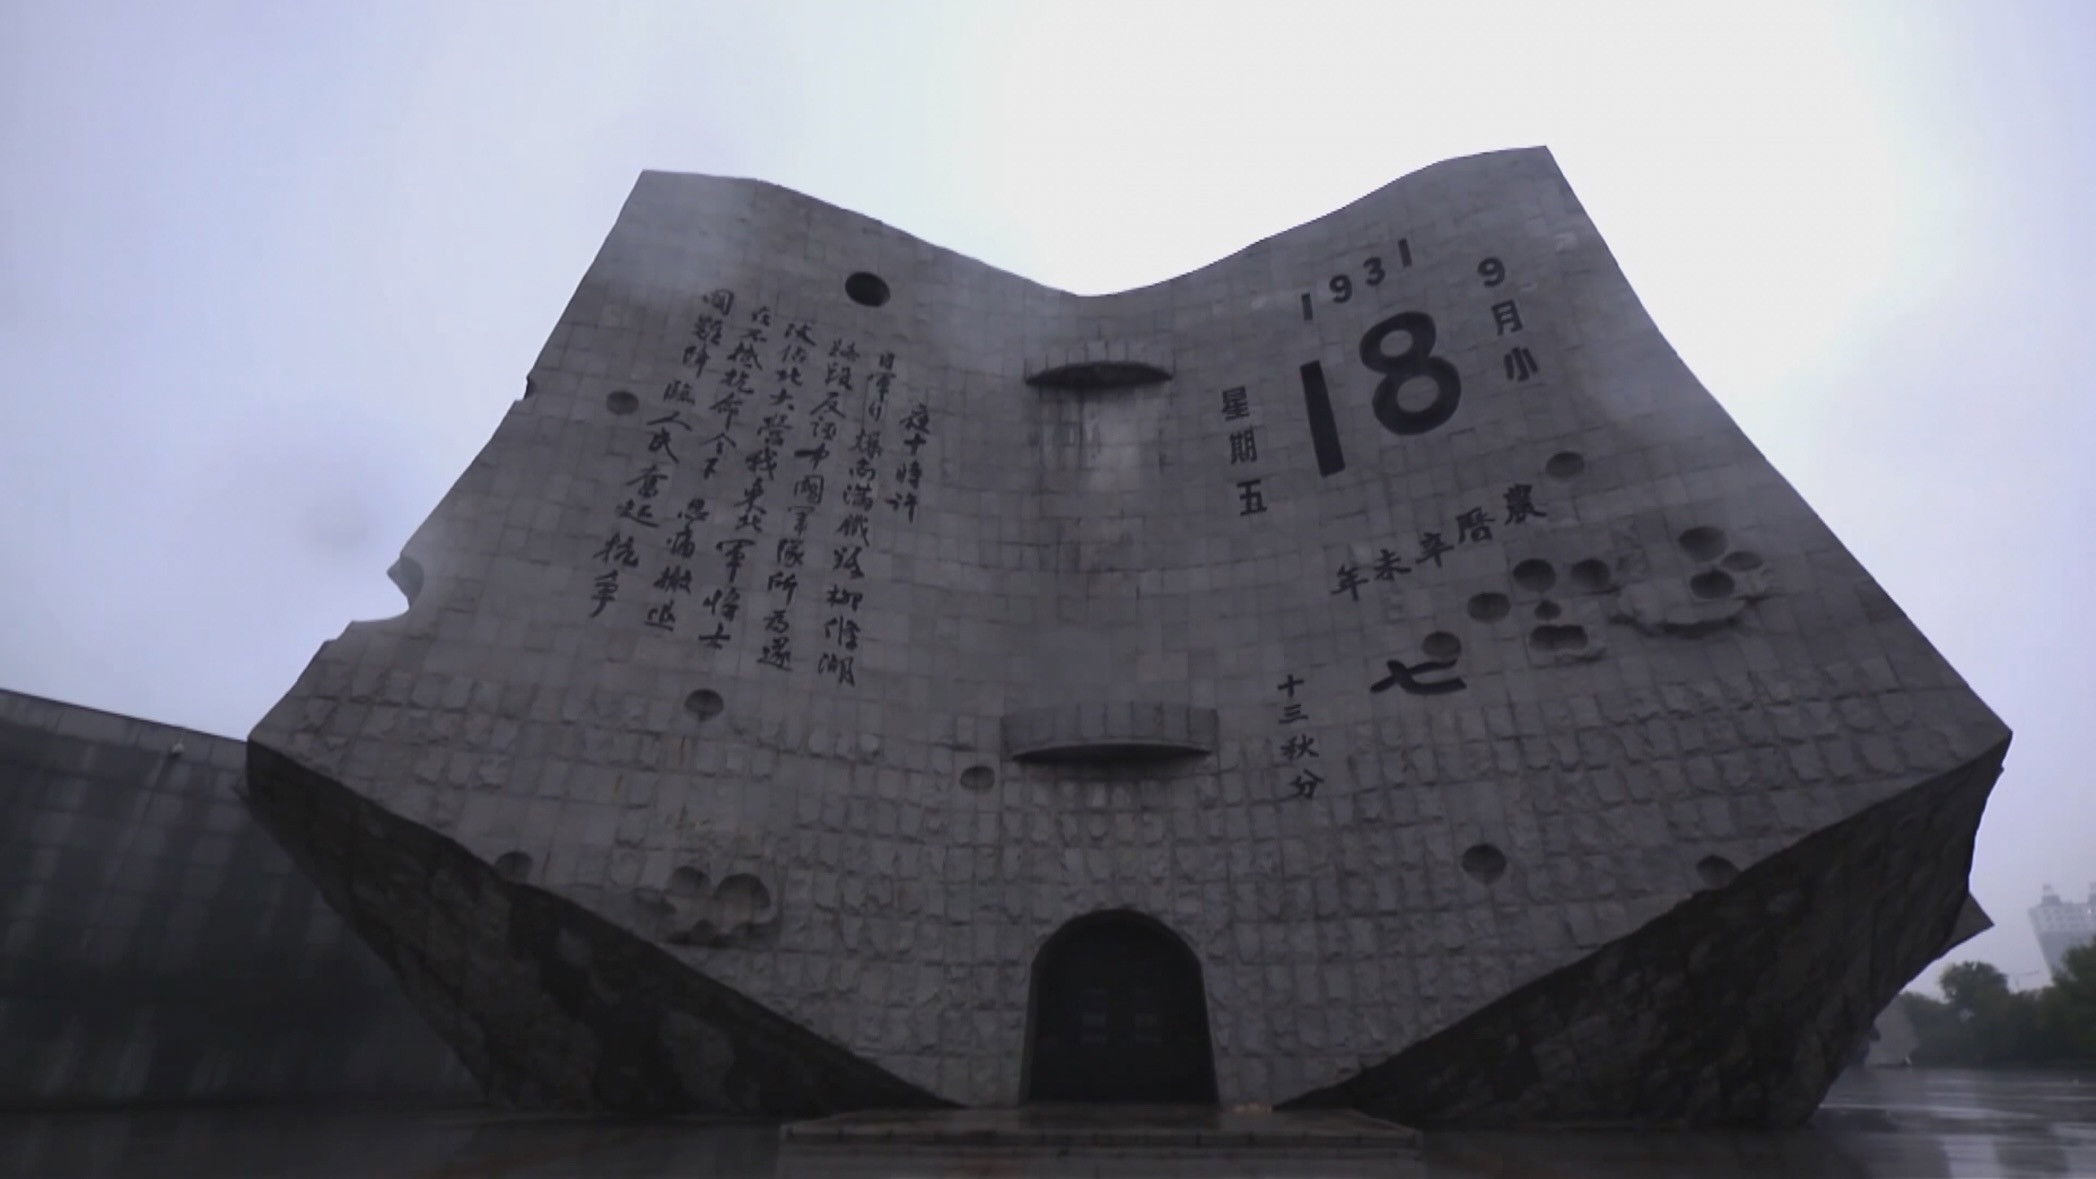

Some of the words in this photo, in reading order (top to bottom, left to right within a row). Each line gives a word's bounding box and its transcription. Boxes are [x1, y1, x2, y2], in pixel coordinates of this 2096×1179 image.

[1221, 386, 1268, 516] 星期五
[1300, 310, 1462, 478] 18
